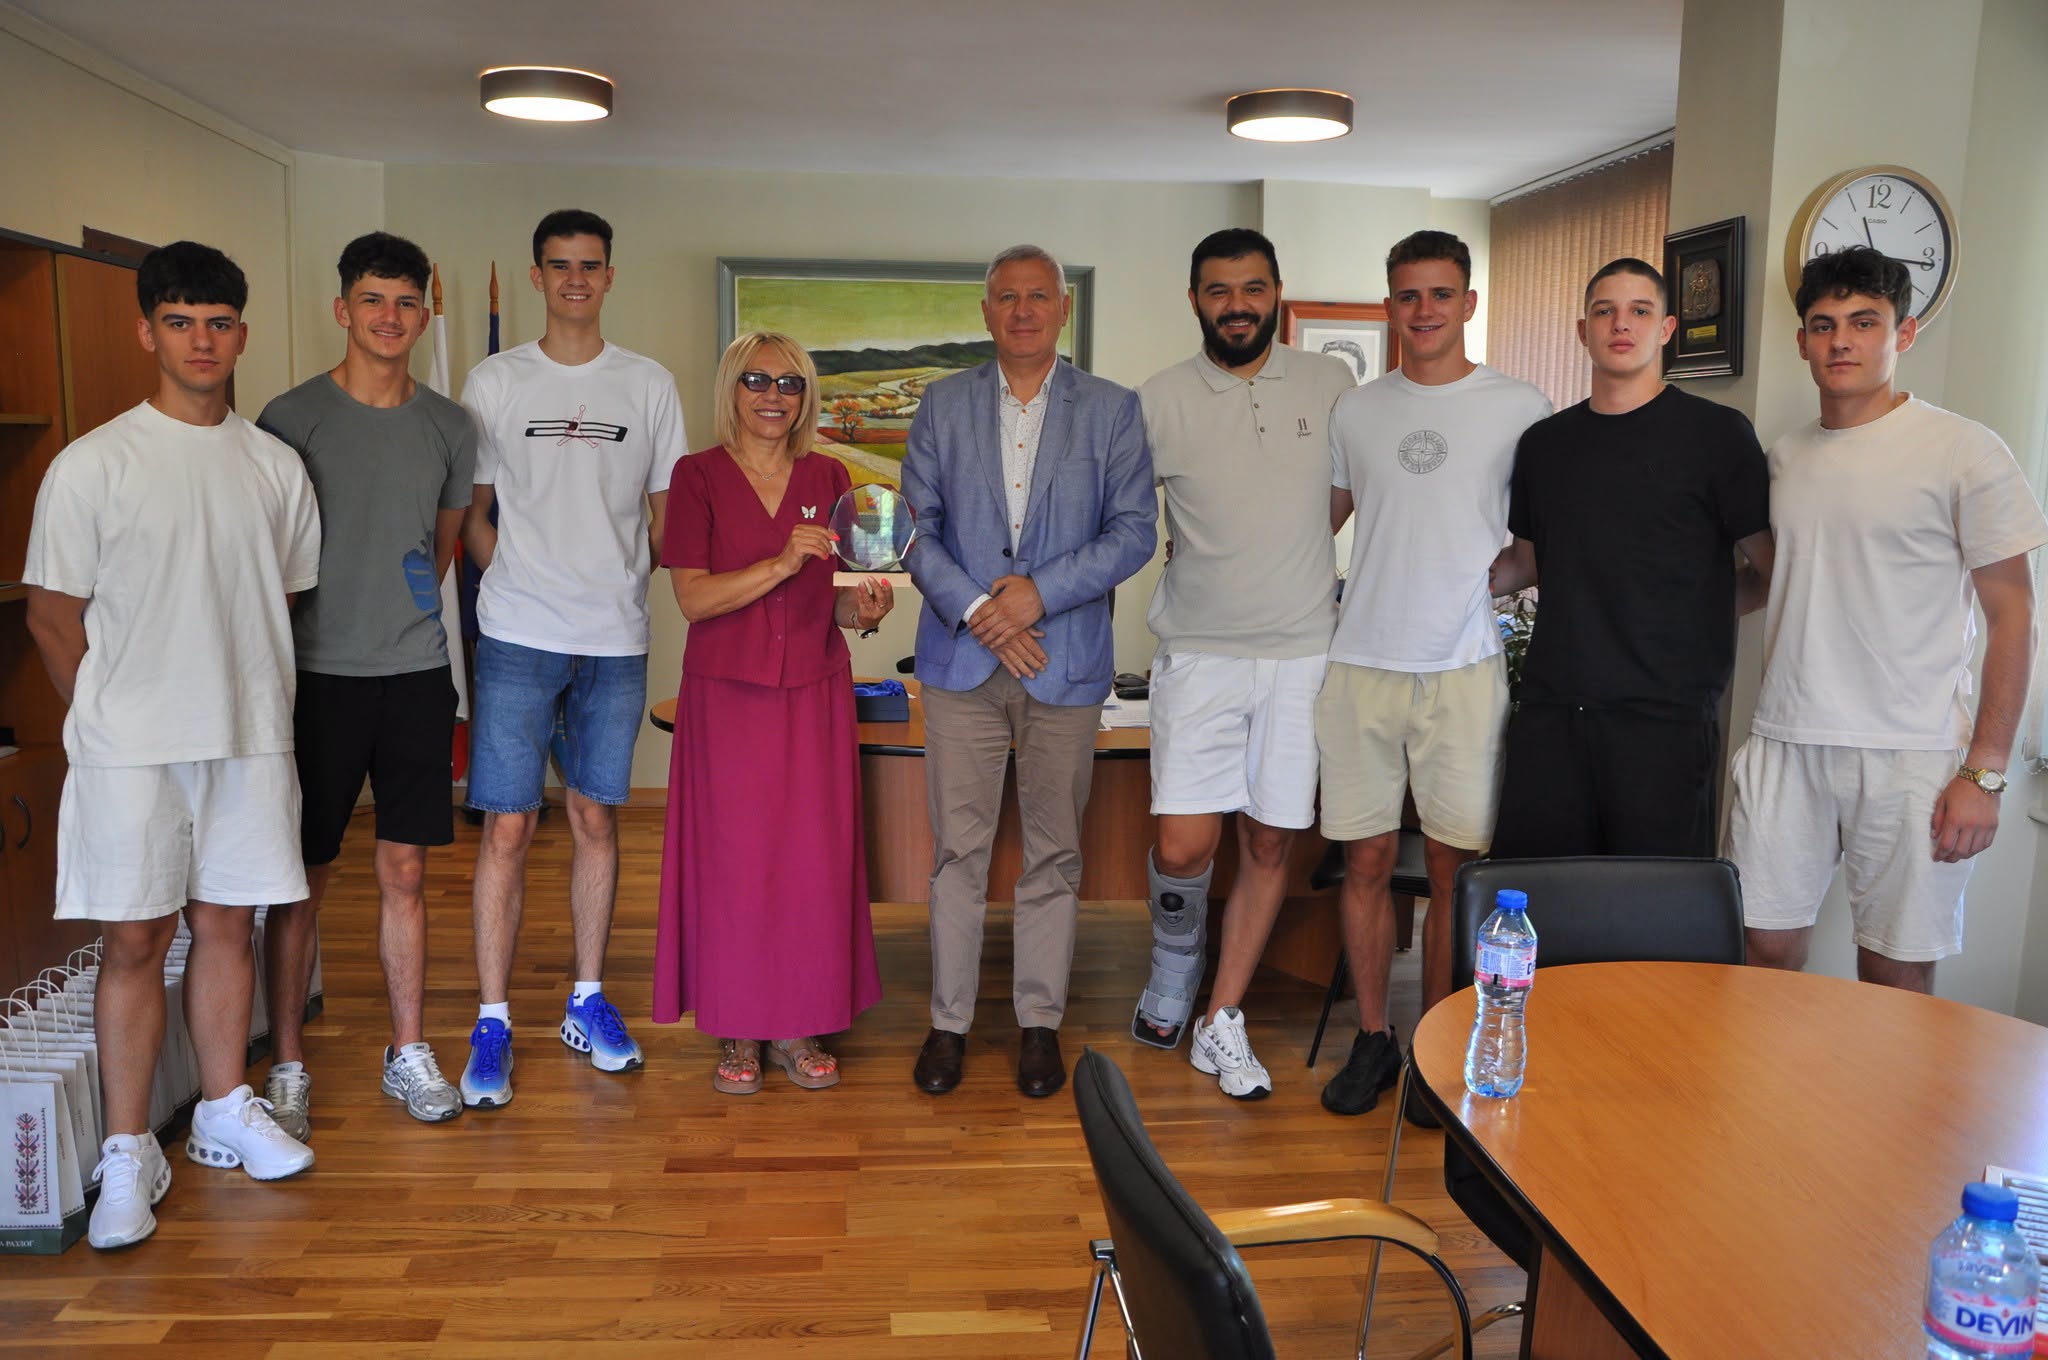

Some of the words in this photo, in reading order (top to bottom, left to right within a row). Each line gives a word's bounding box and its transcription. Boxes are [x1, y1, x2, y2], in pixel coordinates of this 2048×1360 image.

[1867, 184, 1892, 209] 12
[1920, 247, 1935, 271] 3
[1956, 1306, 2034, 1336] DEVIN
